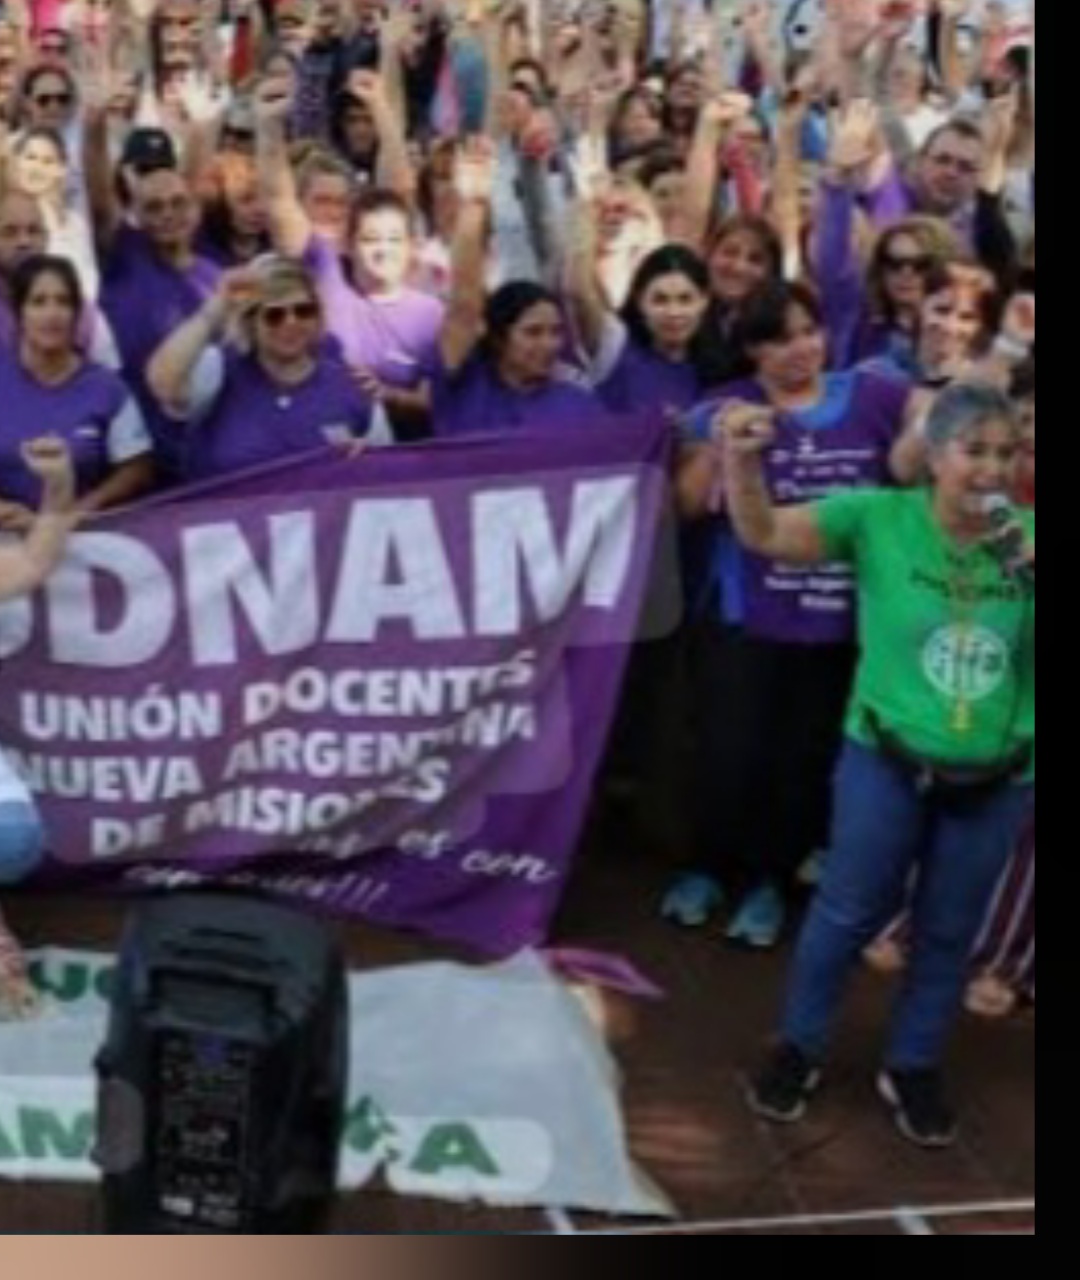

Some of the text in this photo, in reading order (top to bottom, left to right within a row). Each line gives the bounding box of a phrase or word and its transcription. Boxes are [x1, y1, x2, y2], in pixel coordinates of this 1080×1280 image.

[21, 684, 221, 740] UNIÓN
[222, 703, 536, 782] ARGENNA
[184, 757, 450, 835] MISIOS
